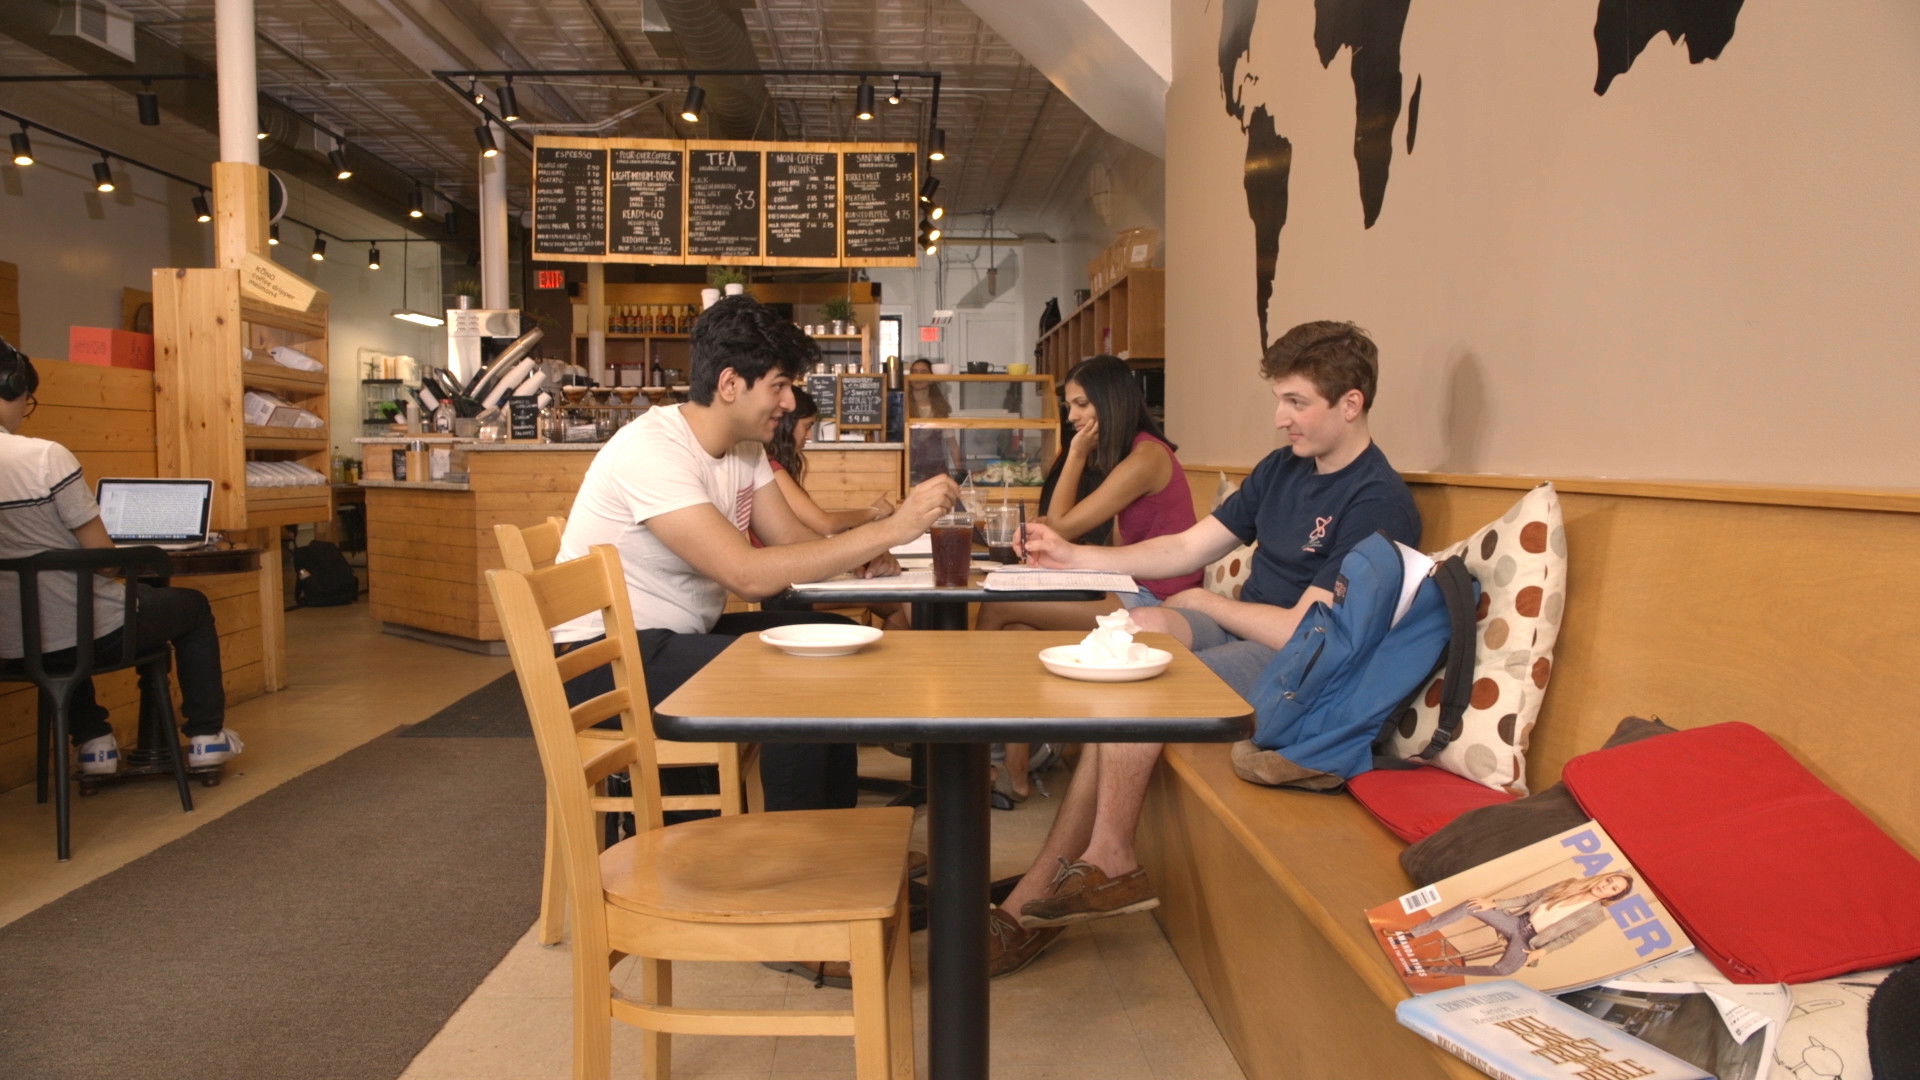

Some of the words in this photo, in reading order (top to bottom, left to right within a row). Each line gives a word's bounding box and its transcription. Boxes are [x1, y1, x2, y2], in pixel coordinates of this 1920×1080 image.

[555, 151, 592, 160] ESPRESSO
[706, 151, 737, 167] TEA
[788, 165, 816, 174] DRINKS
[735, 188, 755, 210] $3
[622, 210, 645, 219] READY
[650, 210, 664, 220] GO
[539, 271, 561, 288] EXIT
[1560, 829, 1672, 957] PAER
[1395, 931, 1415, 957] AMANDA
[1494, 1016, 1549, 1036] YOU
[1521, 1027, 1576, 1048] CAN
[1531, 1037, 1612, 1065] TRUST
